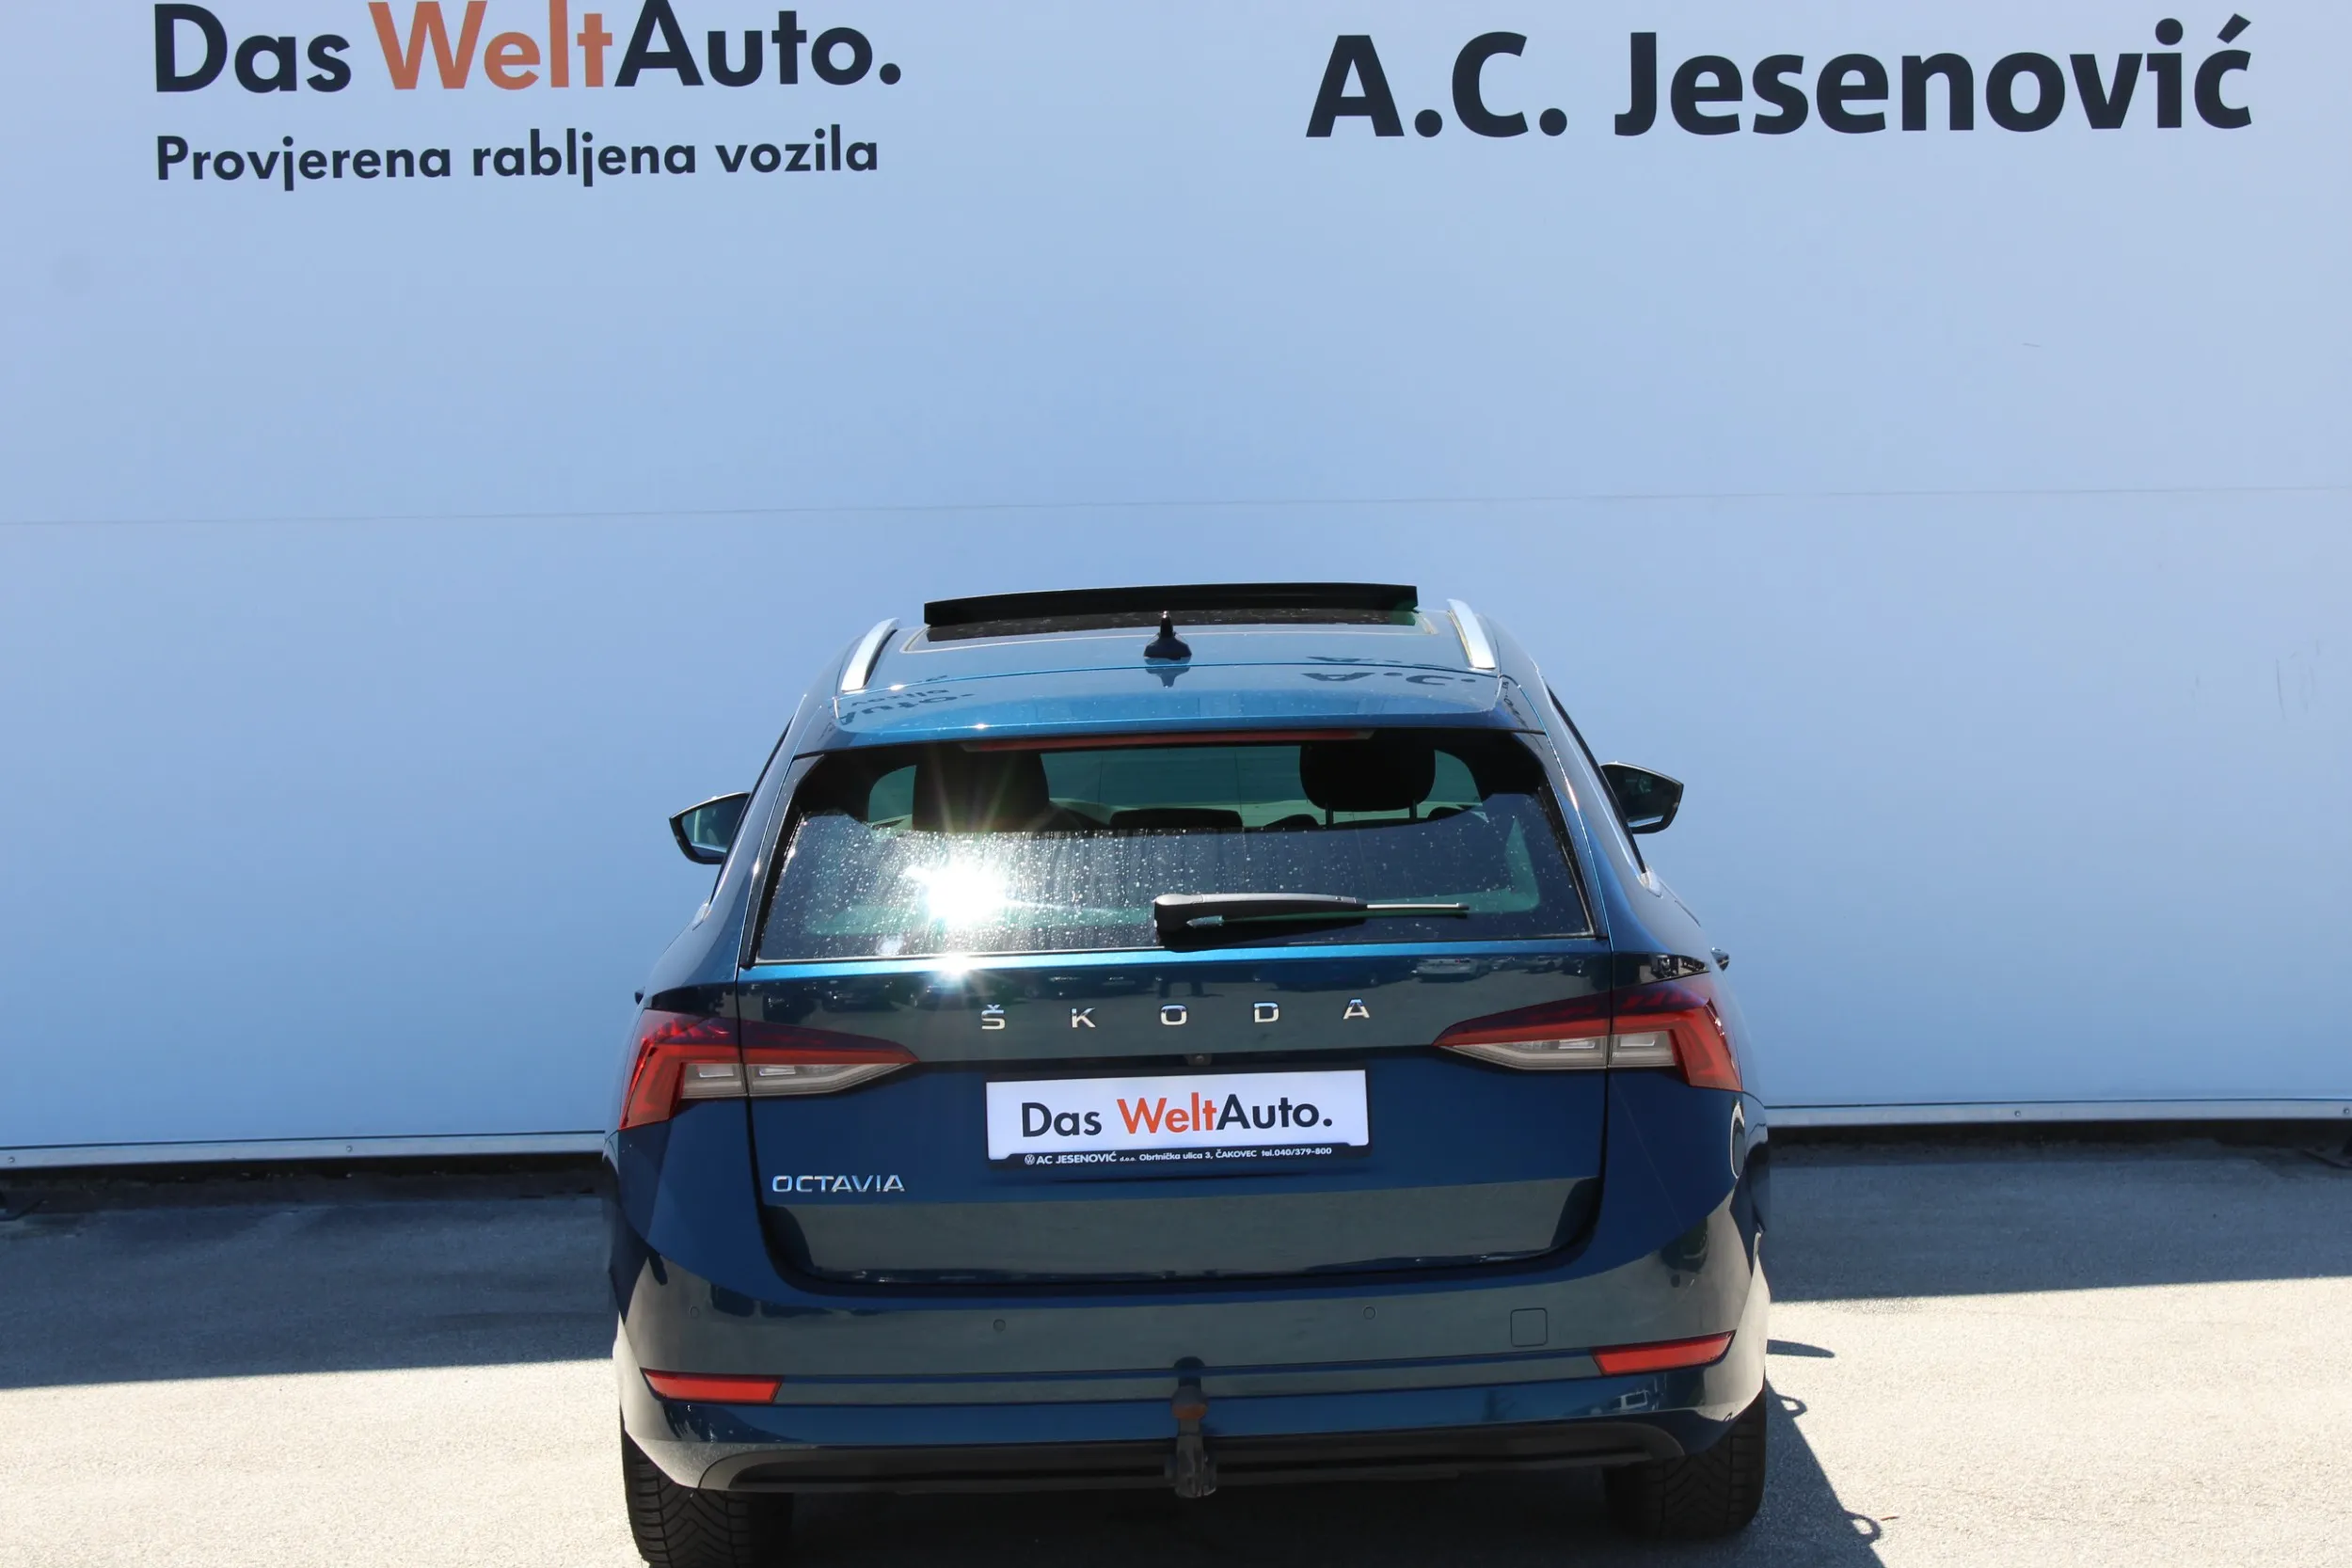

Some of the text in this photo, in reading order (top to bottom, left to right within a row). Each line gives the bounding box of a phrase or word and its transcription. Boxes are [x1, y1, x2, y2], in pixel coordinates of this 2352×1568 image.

[154, 0, 902, 93] Das WeltAuto.
[1305, 12, 2252, 138] A.C. Jesenović
[156, 124, 879, 192] Provjerena rabljena vozila
[980, 998, 1371, 1031] ŠKODA
[1021, 1092, 1333, 1138] Das WeltAuto.
[1036, 1155, 1053, 1164] AC
[1056, 1151, 1117, 1164] JESENOVIĆ
[1138, 1152, 1181, 1162] Obrtnička
[1183, 1150, 1203, 1160] ulica
[1204, 1150, 1214, 1161] 3,
[1216, 1148, 1257, 1159] ČAKOVEC
[1261, 1147, 1332, 1157] tel.040/379-800
[771, 1174, 906, 1193] OCTAVIA
